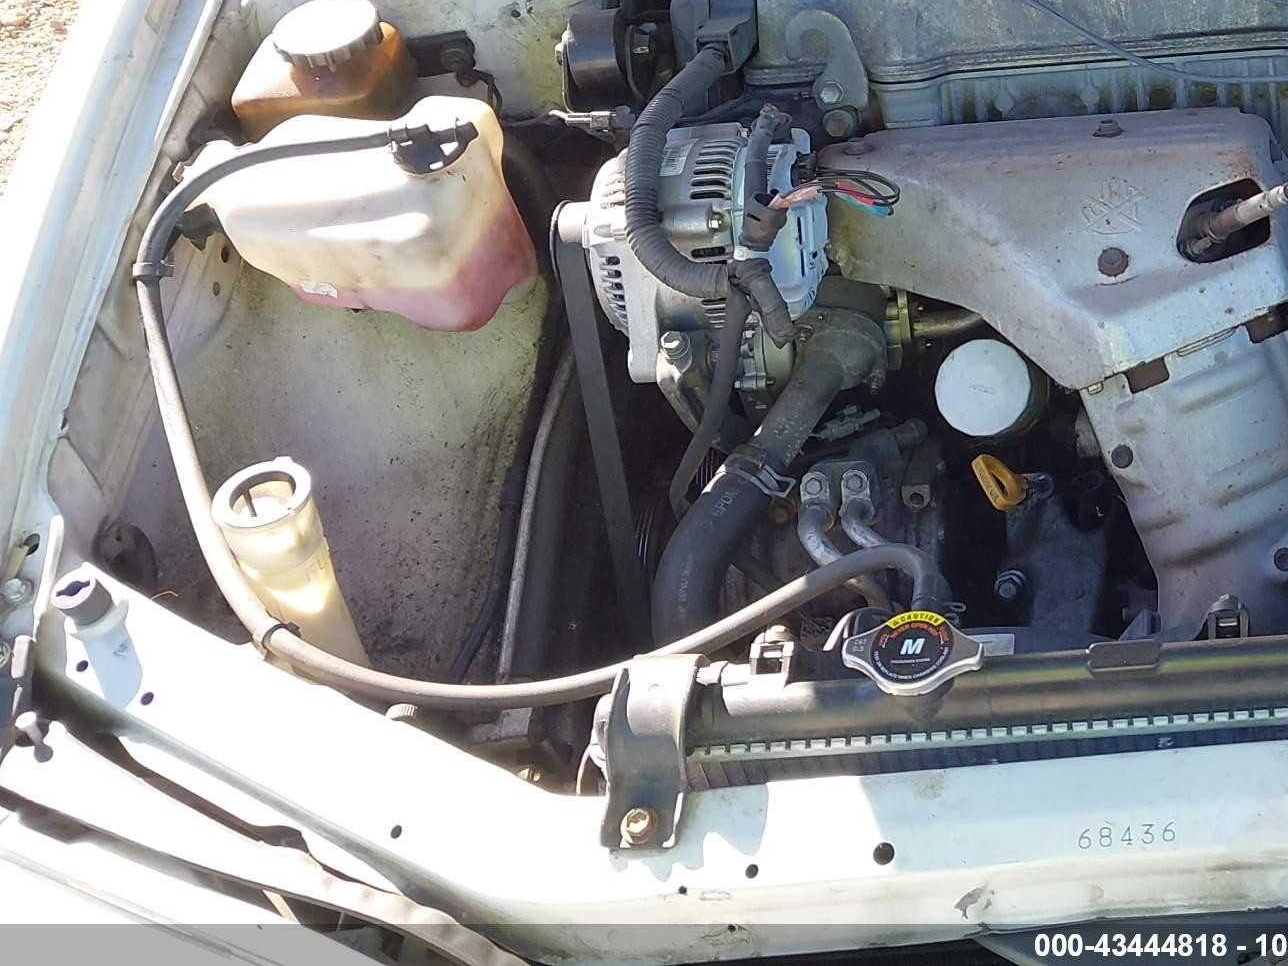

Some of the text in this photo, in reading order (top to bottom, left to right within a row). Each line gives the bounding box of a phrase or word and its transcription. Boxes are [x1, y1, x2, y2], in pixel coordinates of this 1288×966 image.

[900, 613, 941, 624] CAUTION
[899, 638, 925, 655] M
[1078, 821, 1176, 849] 68436
